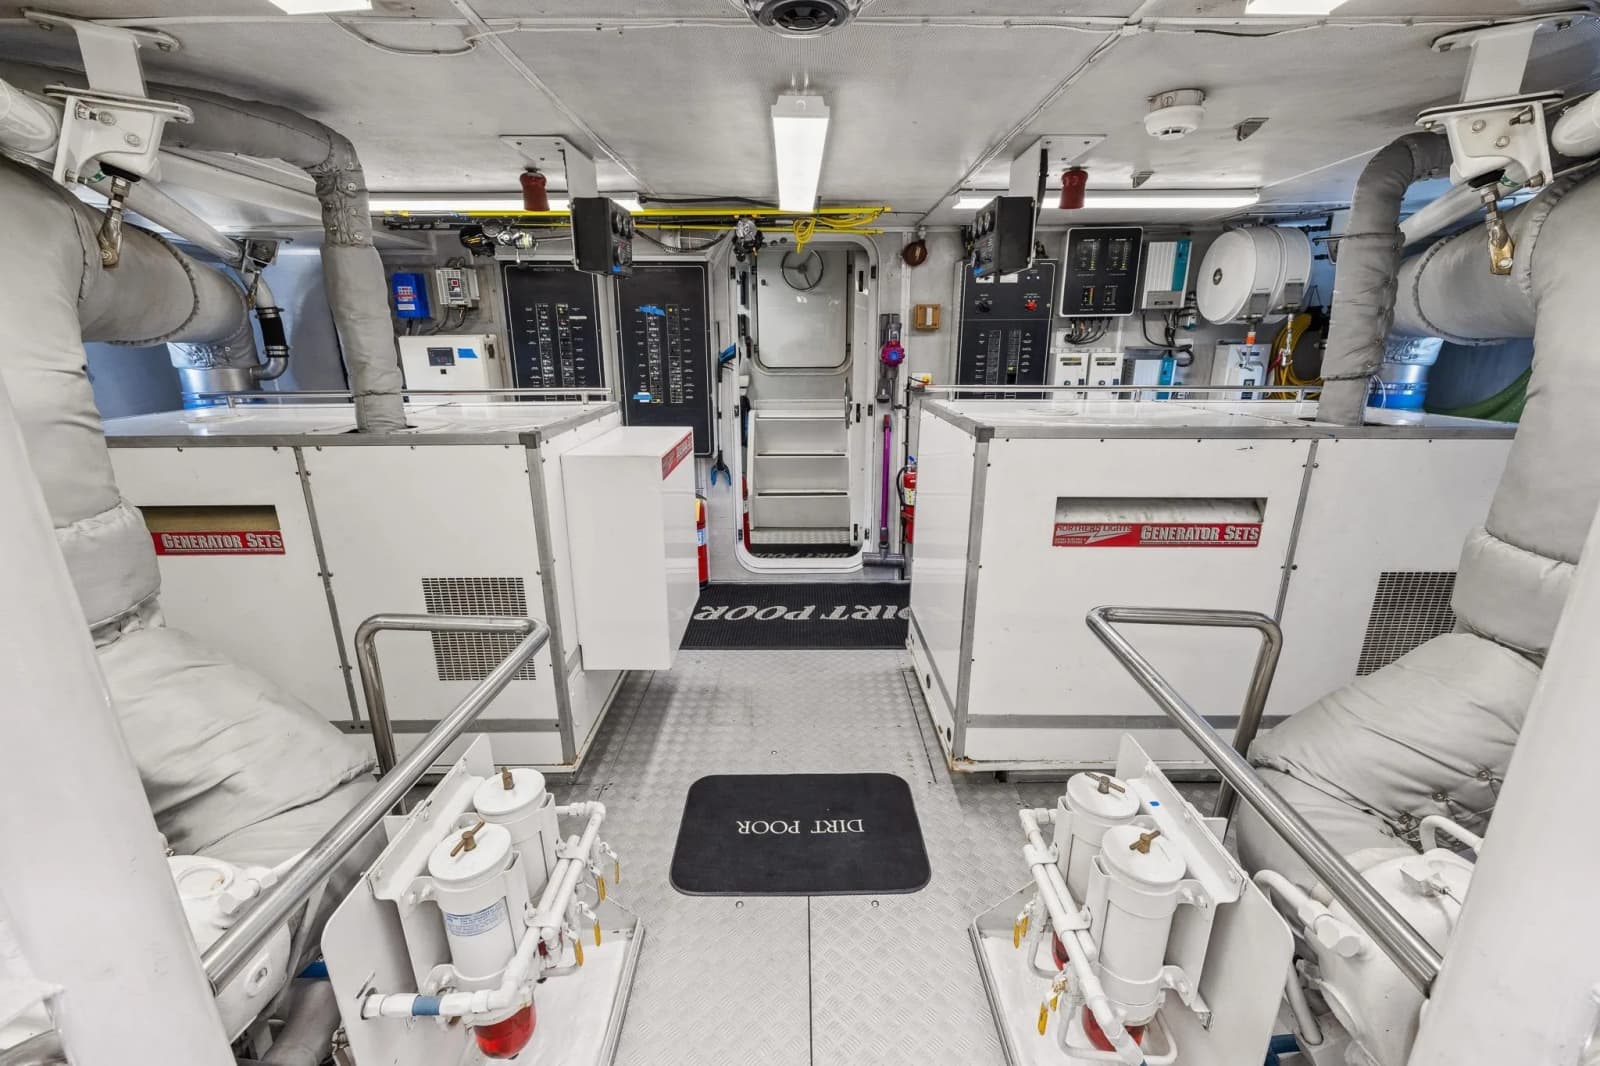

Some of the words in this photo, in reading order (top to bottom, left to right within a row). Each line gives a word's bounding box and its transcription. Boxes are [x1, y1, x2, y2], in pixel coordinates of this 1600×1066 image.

[1141, 525, 1220, 540] GENERATOR
[1224, 525, 1260, 540] SETS
[161, 533, 243, 549] GENERATOR
[245, 533, 282, 548] SETS
[693, 605, 816, 620] POOR
[736, 820, 801, 834] POOR
[810, 819, 865, 834] DIRT
